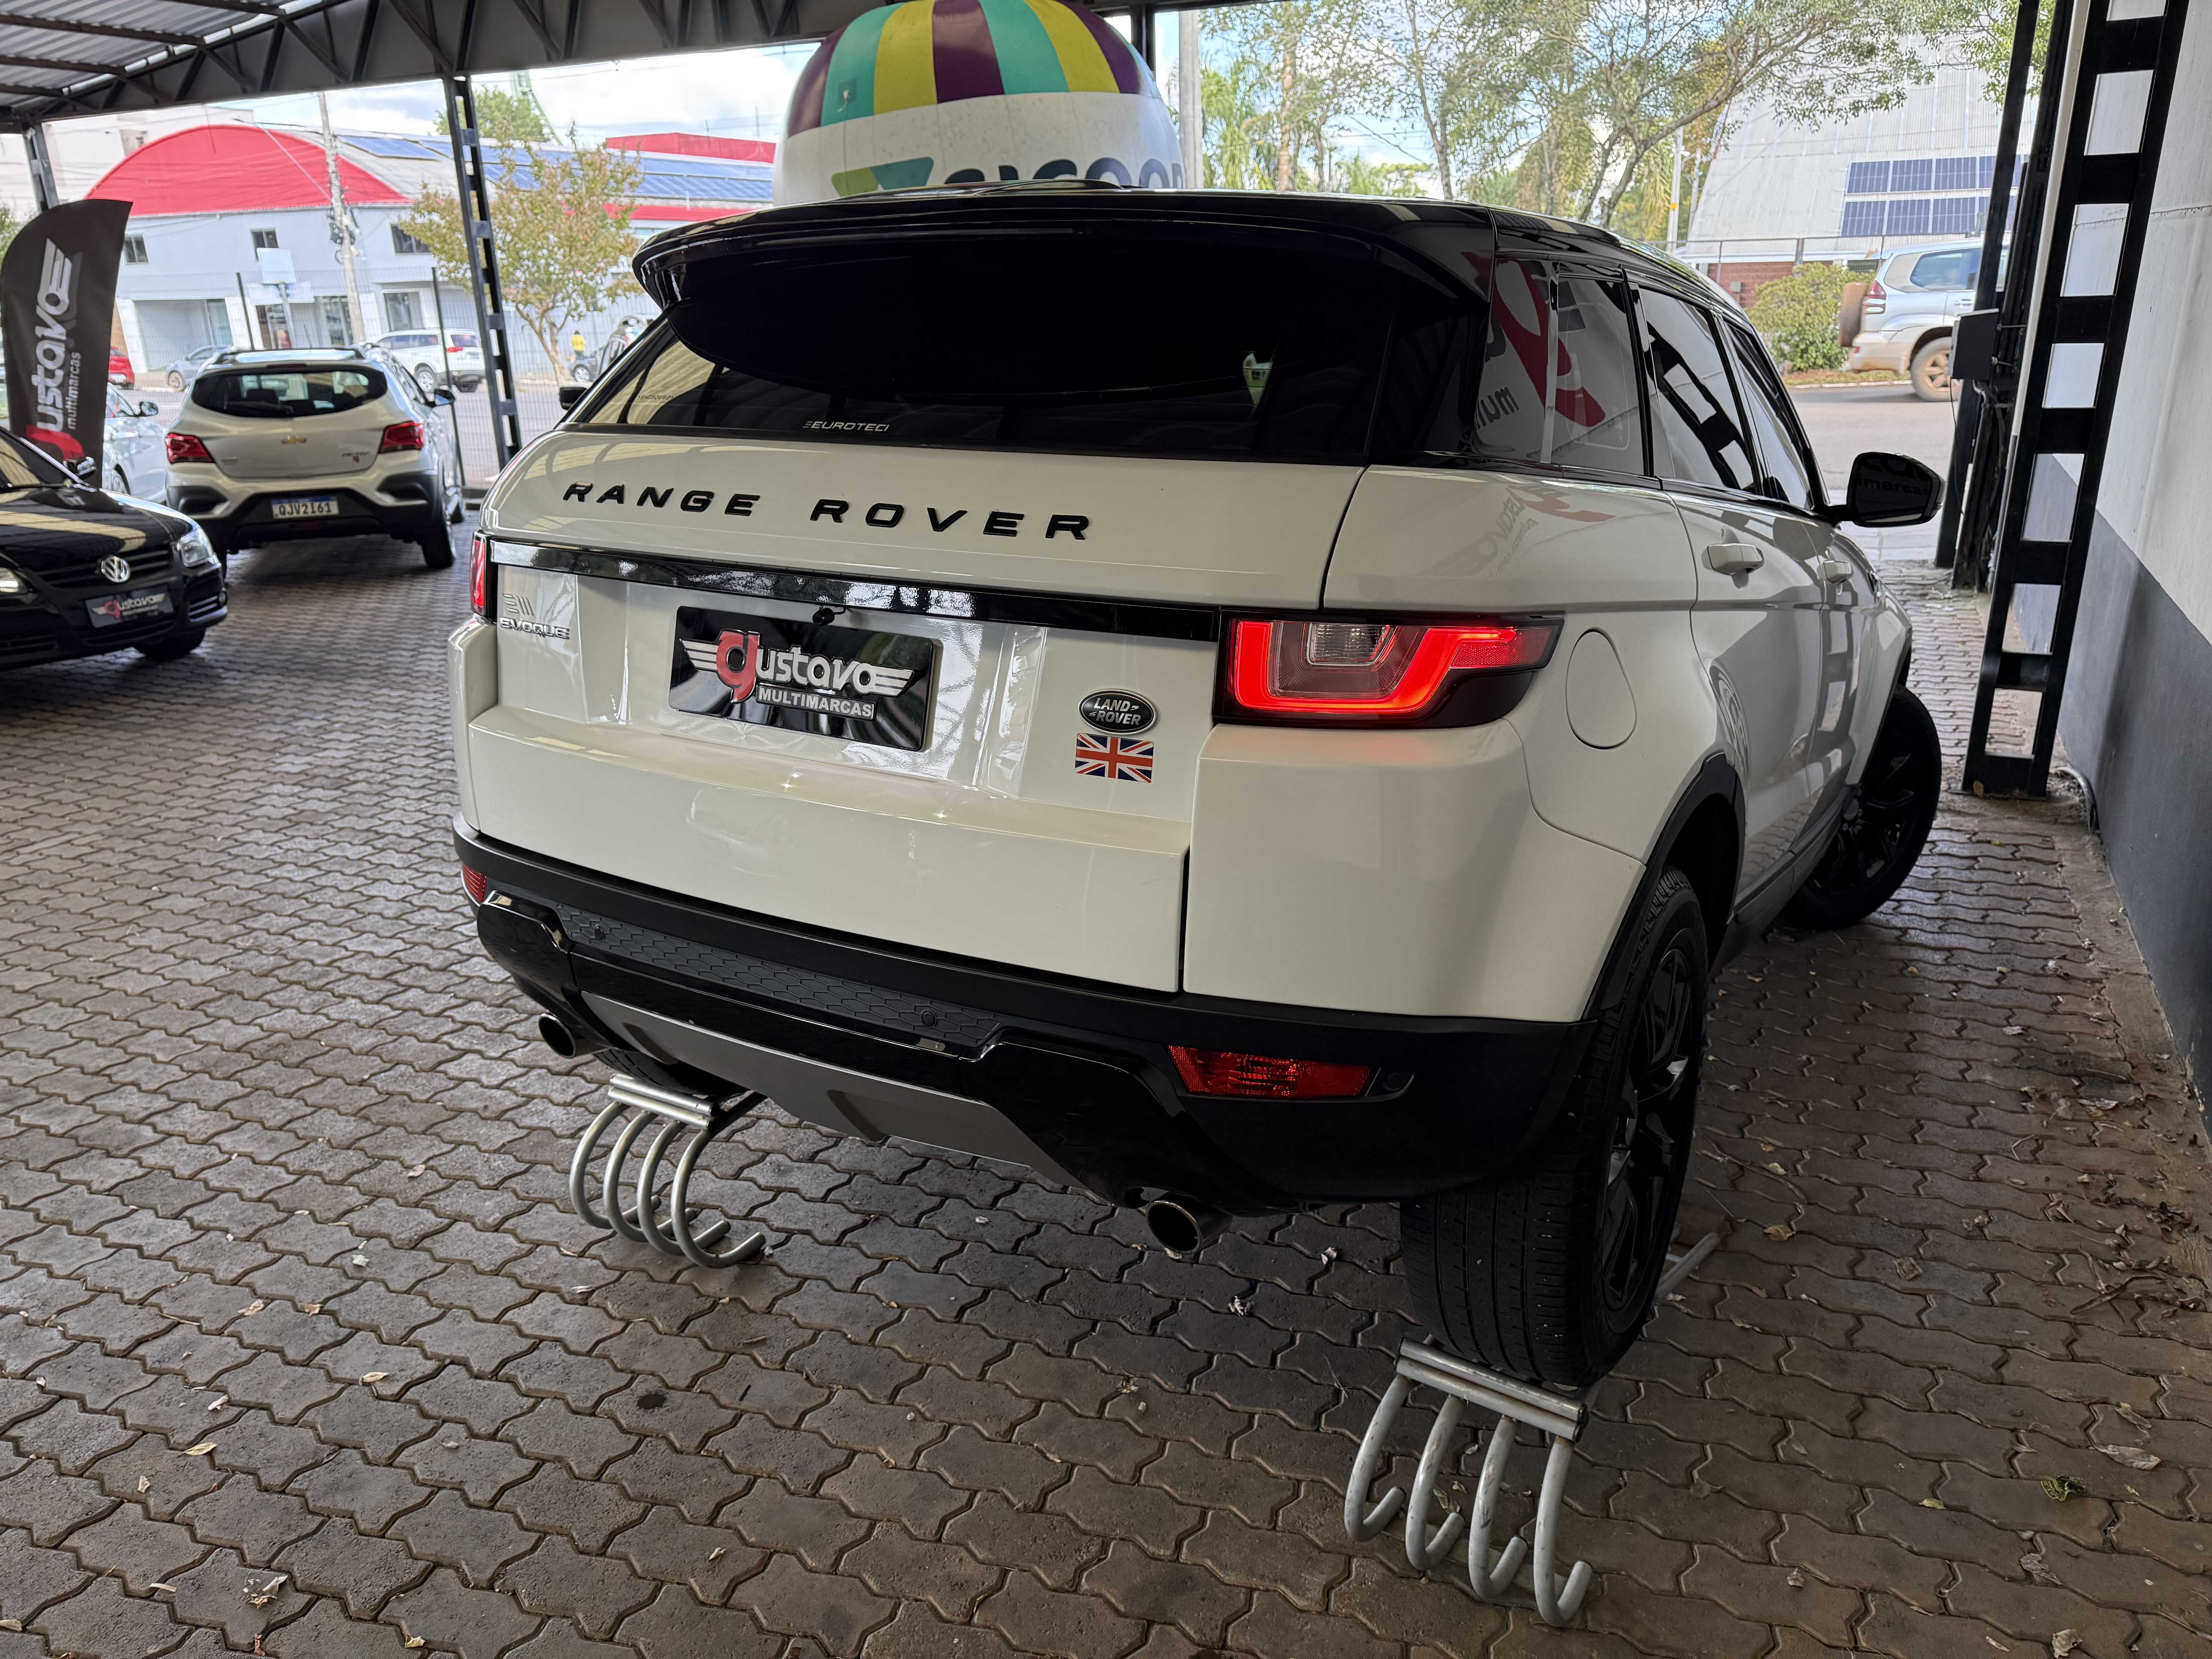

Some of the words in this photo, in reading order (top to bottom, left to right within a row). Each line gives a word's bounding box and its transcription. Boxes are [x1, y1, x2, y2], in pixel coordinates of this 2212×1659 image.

[67, 351, 82, 430] multimarcas
[563, 481, 760, 516] RANGE
[810, 499, 1089, 540] ROVER
[500, 617, 570, 639] EVOQUE
[716, 630, 875, 703] gustavo
[758, 686, 874, 718] MULTIMARCAS
[1094, 698, 1131, 712] LAND
[1096, 711, 1141, 725] ROVER
